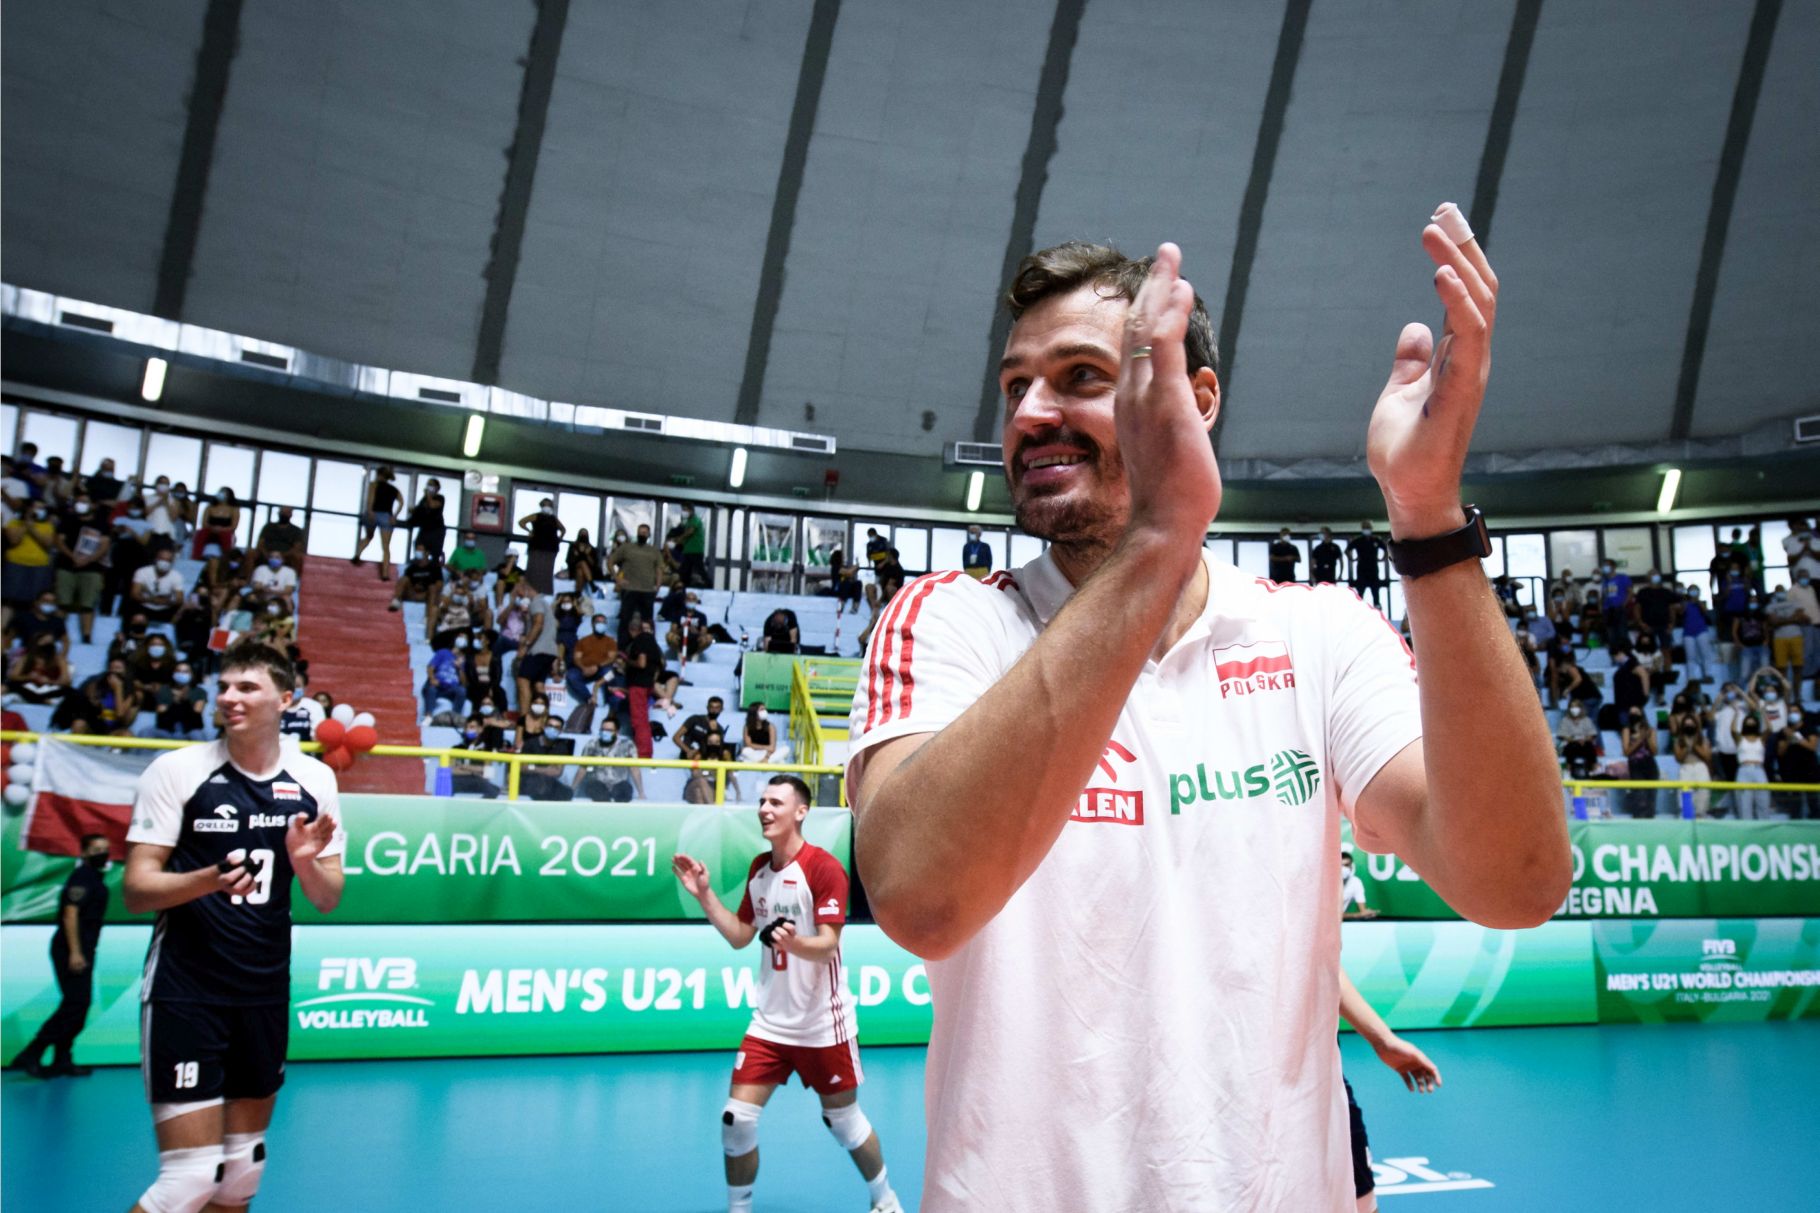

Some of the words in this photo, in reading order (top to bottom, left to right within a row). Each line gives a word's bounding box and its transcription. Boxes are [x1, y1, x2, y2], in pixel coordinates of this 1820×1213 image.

[1220, 672, 1295, 699] POLSKA
[1169, 762, 1270, 815] plus
[1072, 793, 1136, 820] LEN
[249, 814, 286, 830] plus
[341, 831, 522, 876] LGARIA
[539, 835, 657, 876] 2021
[1702, 939, 1736, 954] FIVB
[318, 957, 418, 990] FIVB
[1607, 973, 1650, 991] MEN'S
[1652, 974, 1679, 990] U21
[1679, 972, 1732, 989] WORLD
[455, 967, 609, 1014] MEN'S
[621, 965, 706, 1012] U21
[297, 1009, 429, 1029] VOLLEYBALL
[174, 1061, 199, 1089] 19
